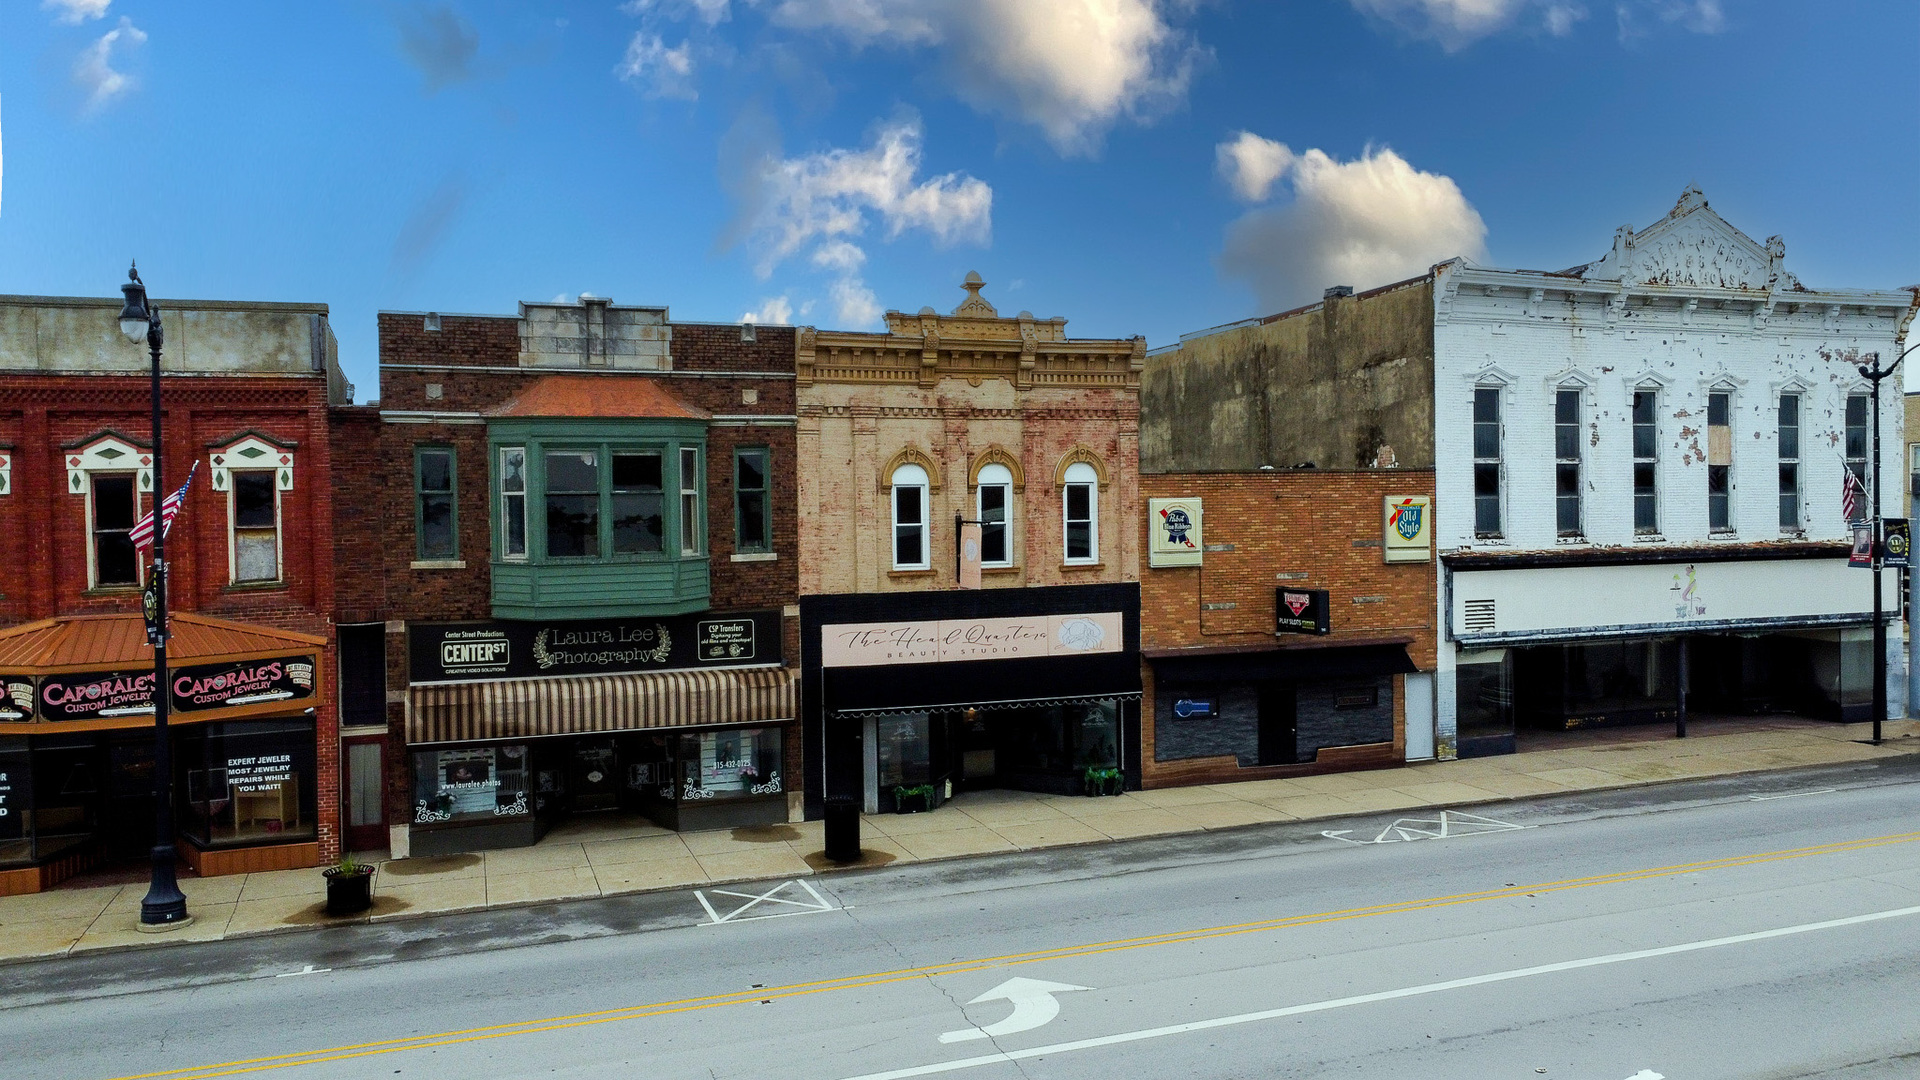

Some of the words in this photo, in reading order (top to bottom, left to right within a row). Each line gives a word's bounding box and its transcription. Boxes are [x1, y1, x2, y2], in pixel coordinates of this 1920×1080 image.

[1403, 510, 1417, 522] Old
[1399, 520, 1420, 537] Style
[720, 623, 744, 632] Transfers
[552, 629, 614, 645] Laura
[618, 626, 654, 642] Lee
[838, 628, 887, 649] The
[890, 626, 962, 649] Head
[962, 624, 1048, 646] Quarters
[553, 648, 653, 665] Photography
[887, 649, 948, 658] BEAUTY
[961, 646, 1018, 655] STUDIO
[174, 662, 282, 698] CAPORALE'S
[193, 691, 231, 704] CUSTOM
[232, 681, 272, 696] JEWELRY
[65, 700, 106, 713] CUSTOM
[108, 692, 152, 706] JEWELRY
[228, 758, 256, 766] EXPERT
[257, 755, 290, 764] JEWELER
[252, 764, 290, 774] JEWELRY
[229, 776, 263, 785] REPAIRS
[264, 774, 290, 782] WHILE
[442, 780, 501, 790] www.lauralee.photos
